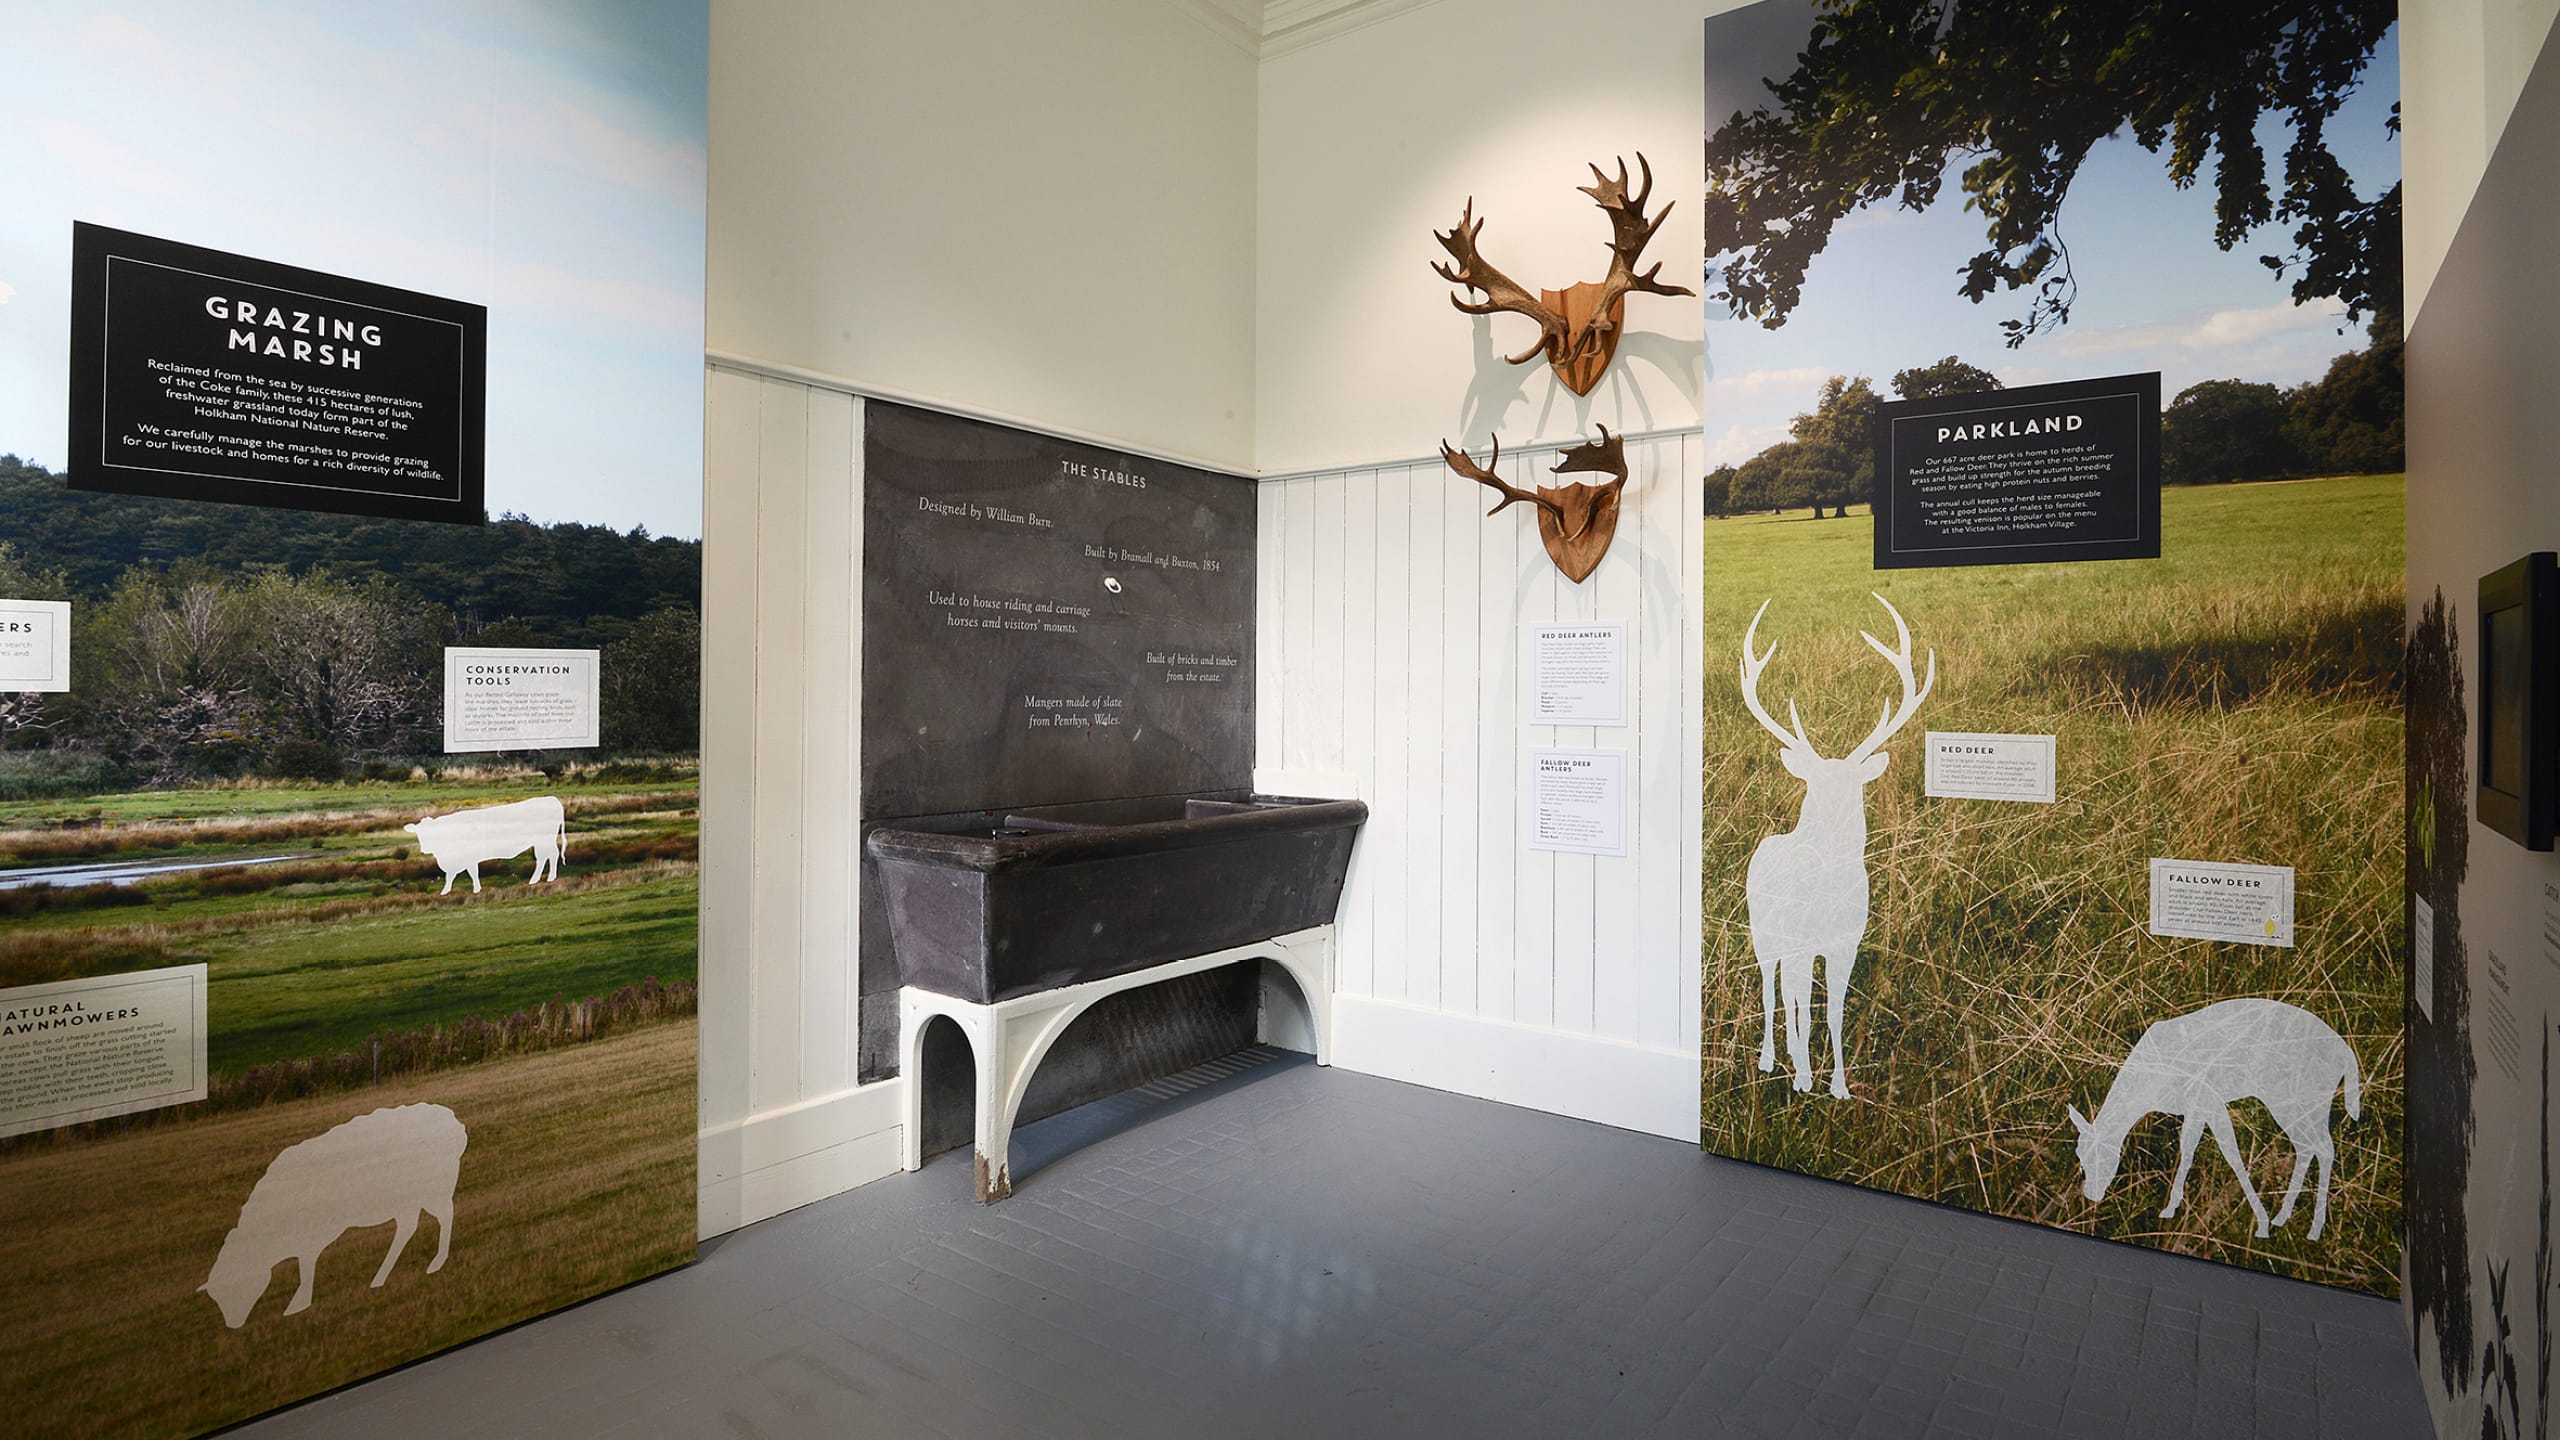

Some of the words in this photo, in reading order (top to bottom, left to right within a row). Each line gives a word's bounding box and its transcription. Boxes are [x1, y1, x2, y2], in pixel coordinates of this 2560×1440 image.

[206, 297, 381, 346] GRAZING
[229, 329, 360, 370] MARSH
[148, 359, 210, 377] Reclaimed
[215, 369, 242, 381] from
[246, 375, 265, 385] the
[269, 380, 287, 389] sea
[291, 381, 304, 393] by
[308, 386, 361, 400] successive
[365, 395, 423, 409] generations
[159, 376, 172, 384] of
[176, 378, 196, 388] the
[200, 381, 231, 393] Coke
[273, 392, 303, 404] these
[307, 397, 327, 407] 415
[331, 400, 375, 414] hectares
[378, 407, 390, 416] of
[166, 389, 230, 406] freshwater
[233, 401, 285, 414] grassland
[289, 408, 319, 420] today
[324, 411, 348, 422] form
[352, 417, 374, 426] part
[378, 419, 389, 427] of
[392, 421, 408, 431] the
[195, 406, 246, 421] Holkham
[251, 414, 298, 428] National
[303, 421, 340, 434] Nature
[345, 426, 388, 440] Reserve.
[1939, 416, 2082, 443] PARKLAND
[138, 424, 160, 435] We
[164, 429, 214, 443] carefully
[219, 436, 262, 449] manage
[267, 440, 284, 450] the
[289, 444, 333, 456] marshes
[337, 449, 348, 457] to
[352, 452, 391, 463] provide
[394, 457, 429, 469] grazing
[1943, 456, 1957, 464] 667
[1998, 452, 2015, 460] park
[2087, 444, 2096, 452] of
[123, 435, 142, 446] for
[146, 441, 168, 449] our
[172, 441, 223, 456] livestock
[228, 450, 248, 459] and
[253, 451, 289, 463] homes
[294, 455, 310, 465] for
[323, 460, 343, 469] rich
[347, 462, 390, 476] diversity
[393, 468, 404, 476] of
[407, 470, 443, 480] wildlife.
[2081, 454, 2114, 462] summer
[1061, 460, 1086, 477] THE
[1093, 468, 1146, 489] STABLES
[1948, 474, 1966, 482] build
[1981, 471, 2011, 479] strength
[2076, 464, 2111, 472] breeding
[1985, 481, 2000, 489] high
[1937, 500, 1960, 508] annual
[2054, 491, 2101, 500] manageable
[920, 497, 966, 516] Designed
[971, 504, 982, 520] by
[987, 507, 1024, 524] William
[1029, 513, 1054, 528] Burn.
[2048, 521, 2076, 529] Village.
[1085, 545, 1105, 558] Built
[1109, 548, 1117, 562] by
[1122, 549, 1152, 563] Bramall
[1155, 555, 1169, 568] and
[930, 591, 955, 605] Used
[960, 598, 969, 607] to
[973, 595, 1001, 609] house
[1005, 598, 1032, 614] riding
[1035, 601, 1053, 613] and
[1056, 605, 1090, 618] carriage
[948, 614, 978, 627] horses
[982, 616, 1001, 628] and
[1044, 624, 1078, 633] mounts.
[1147, 652, 1165, 664] Built
[1168, 653, 1175, 666] of
[1178, 653, 1198, 665] bricks
[1201, 655, 1214, 665] and
[1216, 656, 1237, 666] timber
[467, 666, 569, 674] CONSERVATION
[1167, 670, 1184, 683] from
[1186, 670, 1198, 681] the
[1025, 696, 1063, 710] Mangers
[1067, 696, 1089, 707] made
[1093, 696, 1101, 710] of
[1104, 696, 1122, 707] slate
[1030, 715, 1050, 729] from
[1055, 714, 1090, 728] Penrhyn,
[1095, 713, 1120, 726] Wales.
[2170, 875, 2221, 885] FALLOW
[2227, 879, 2260, 888] DEER
